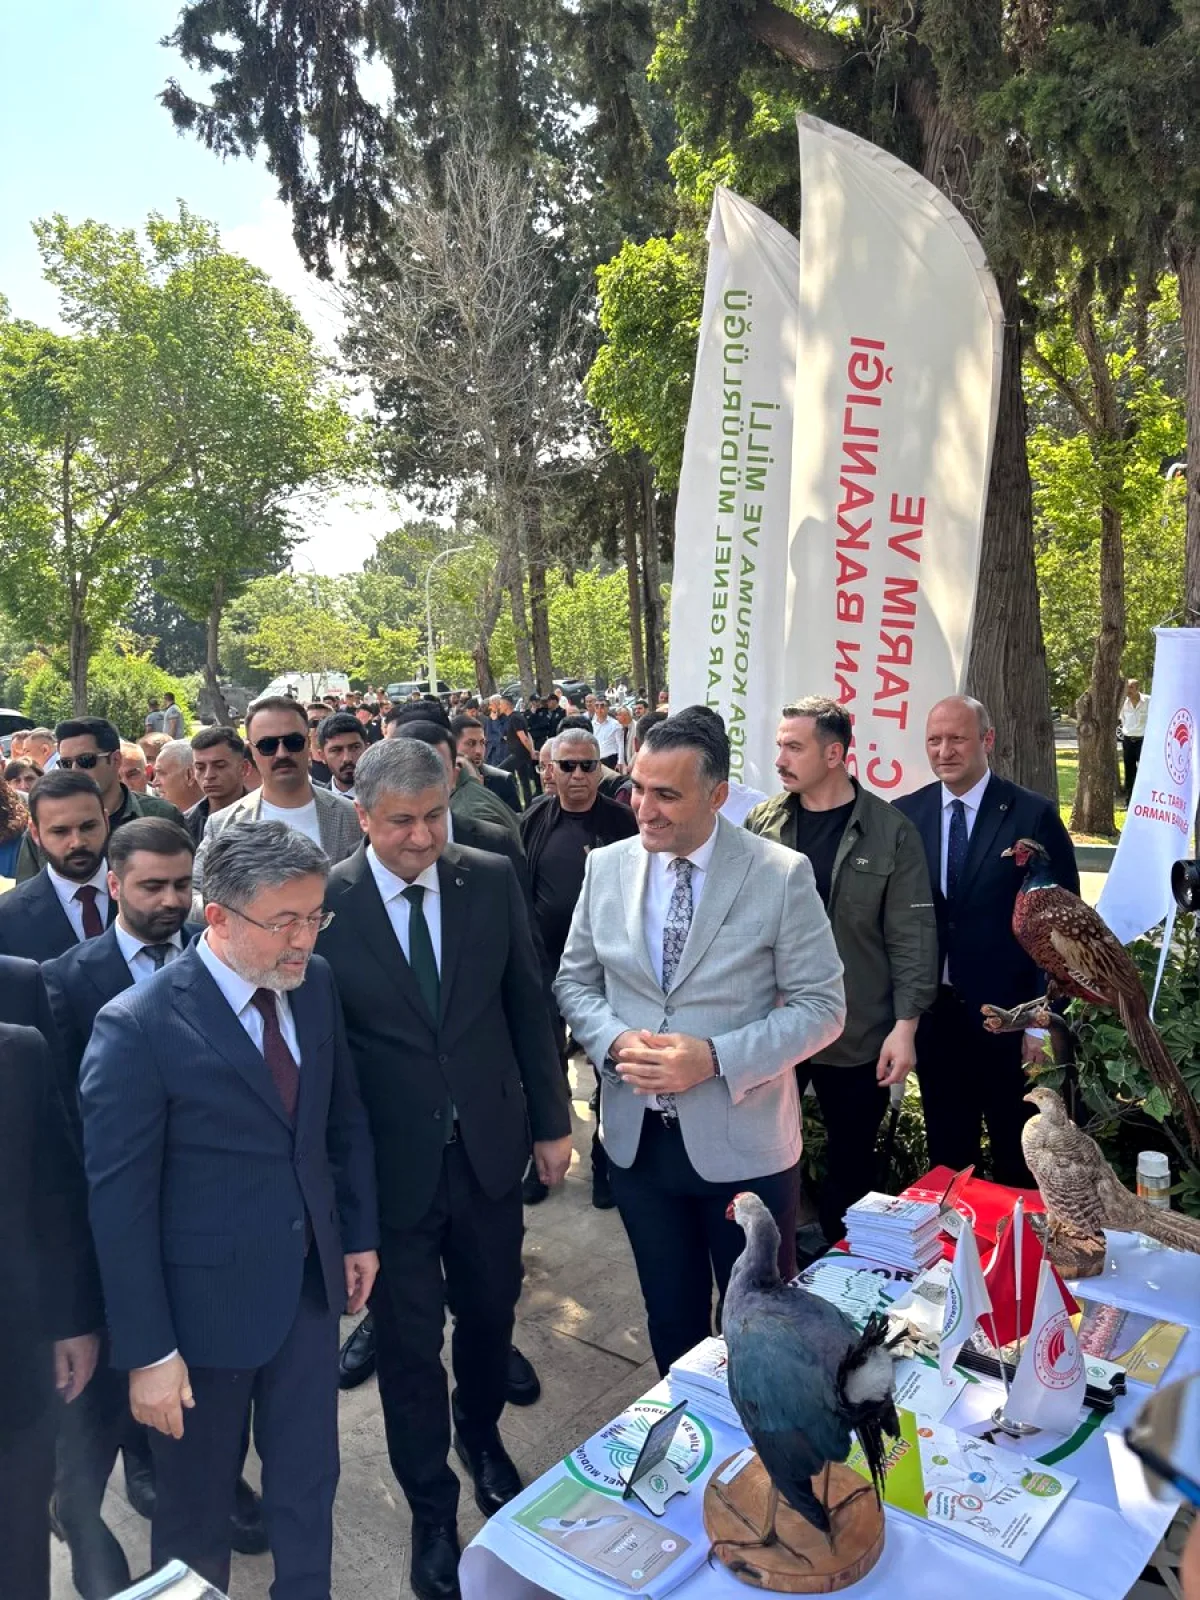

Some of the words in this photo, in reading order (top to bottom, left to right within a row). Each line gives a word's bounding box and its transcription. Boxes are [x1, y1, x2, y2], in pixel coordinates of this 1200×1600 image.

[1151, 790, 1167, 805] T.C.
[1134, 804, 1171, 823] ORMAN
[634, 1406, 668, 1415] KORU
